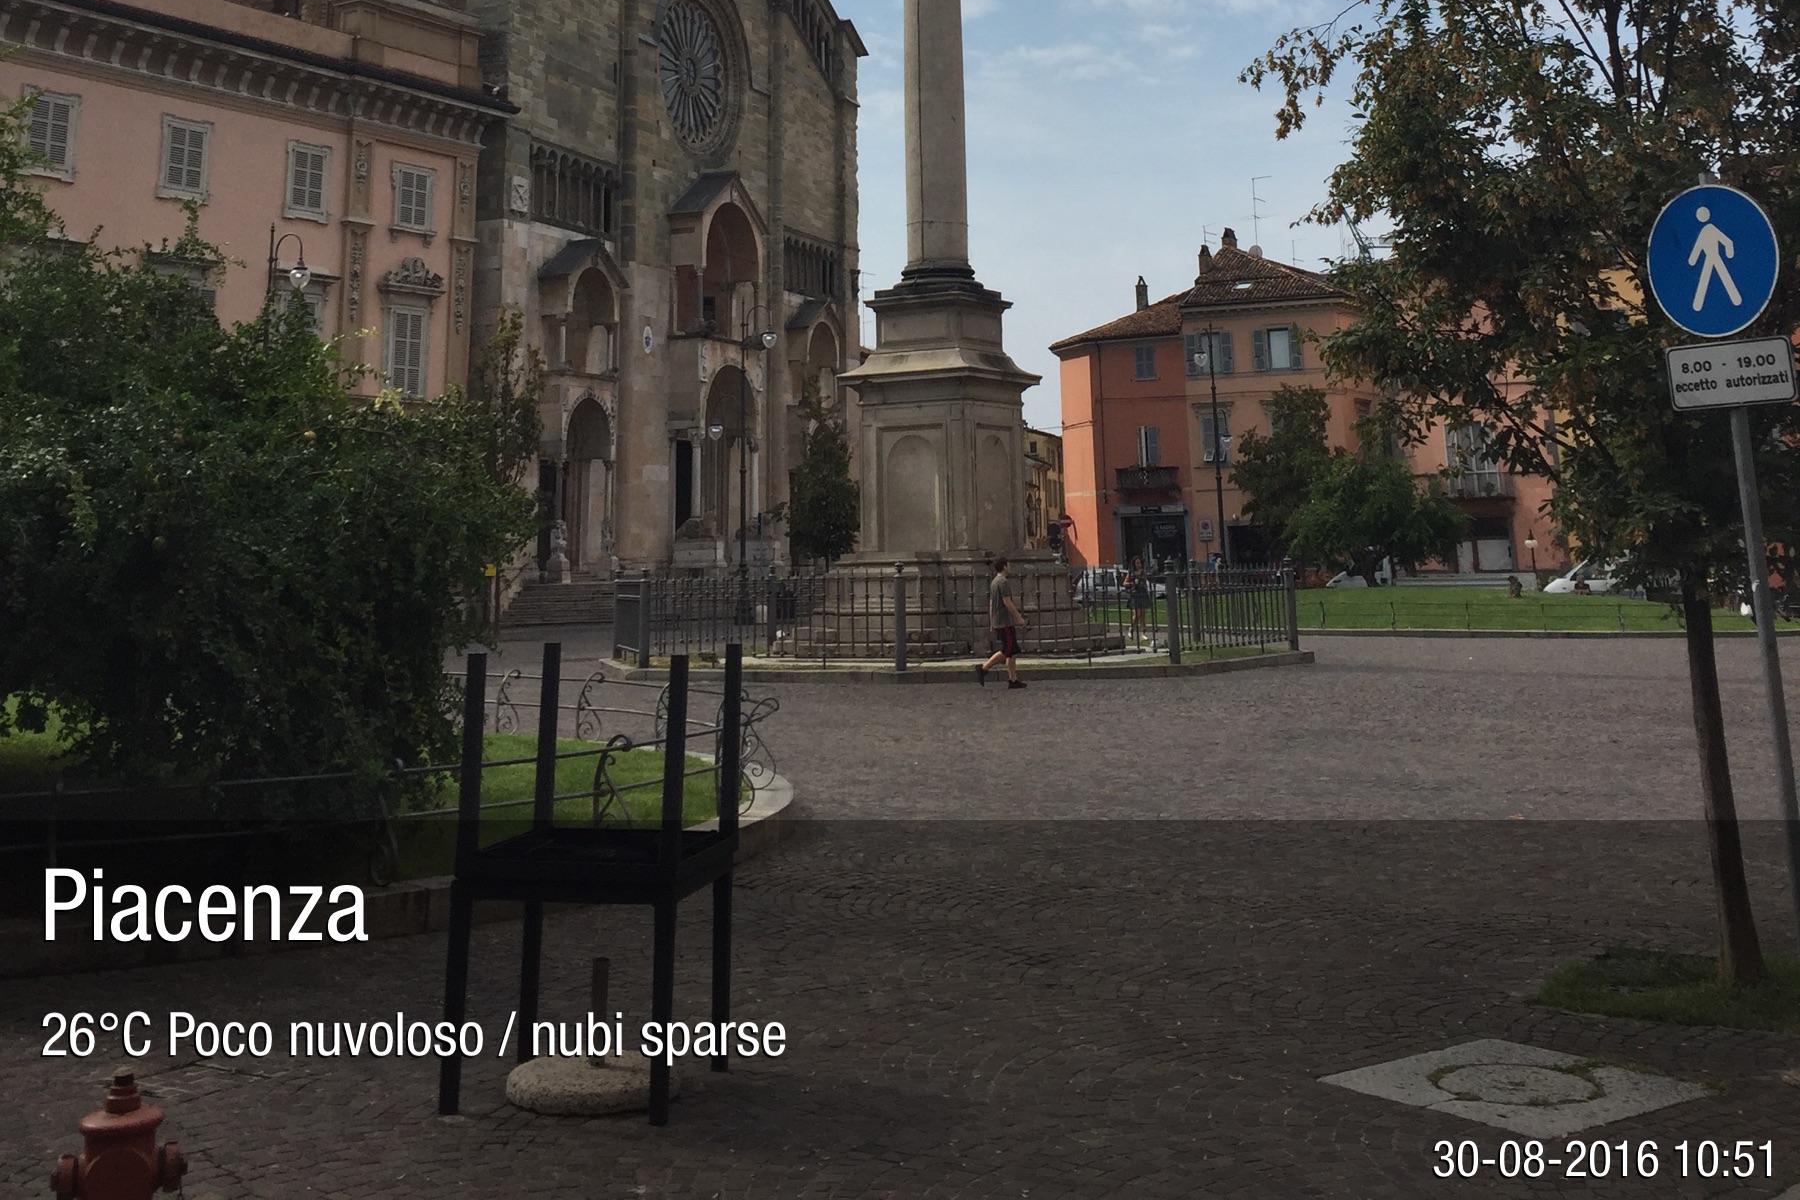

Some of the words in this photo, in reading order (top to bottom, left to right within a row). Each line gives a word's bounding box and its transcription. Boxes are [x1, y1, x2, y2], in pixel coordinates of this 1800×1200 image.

[1682, 361, 1712, 374] 8.00
[1737, 354, 1776, 368] 19.00
[1676, 378, 1717, 392] eccetto
[1726, 371, 1789, 388] autorizzati
